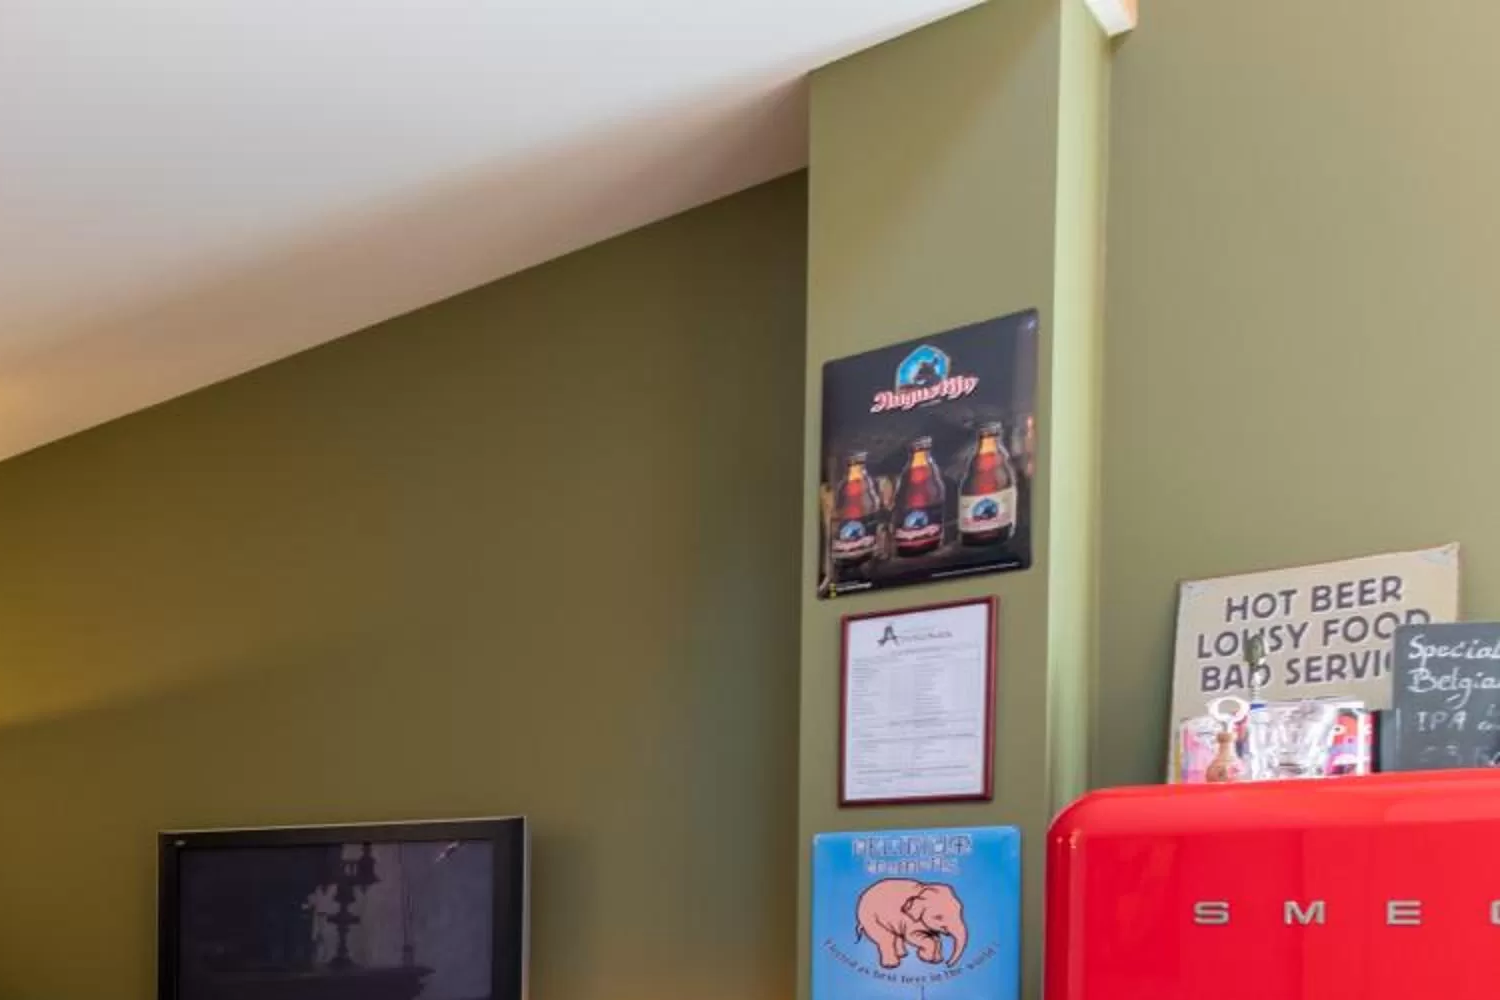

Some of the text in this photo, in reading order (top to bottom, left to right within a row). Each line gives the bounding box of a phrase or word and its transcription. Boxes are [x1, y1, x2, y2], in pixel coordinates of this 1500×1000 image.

[1225, 575, 1404, 623] HOT BEER
[1285, 649, 1392, 685] SERVI
[1406, 666, 1500, 710] Belgia
[1417, 710, 1467, 732] IPA
